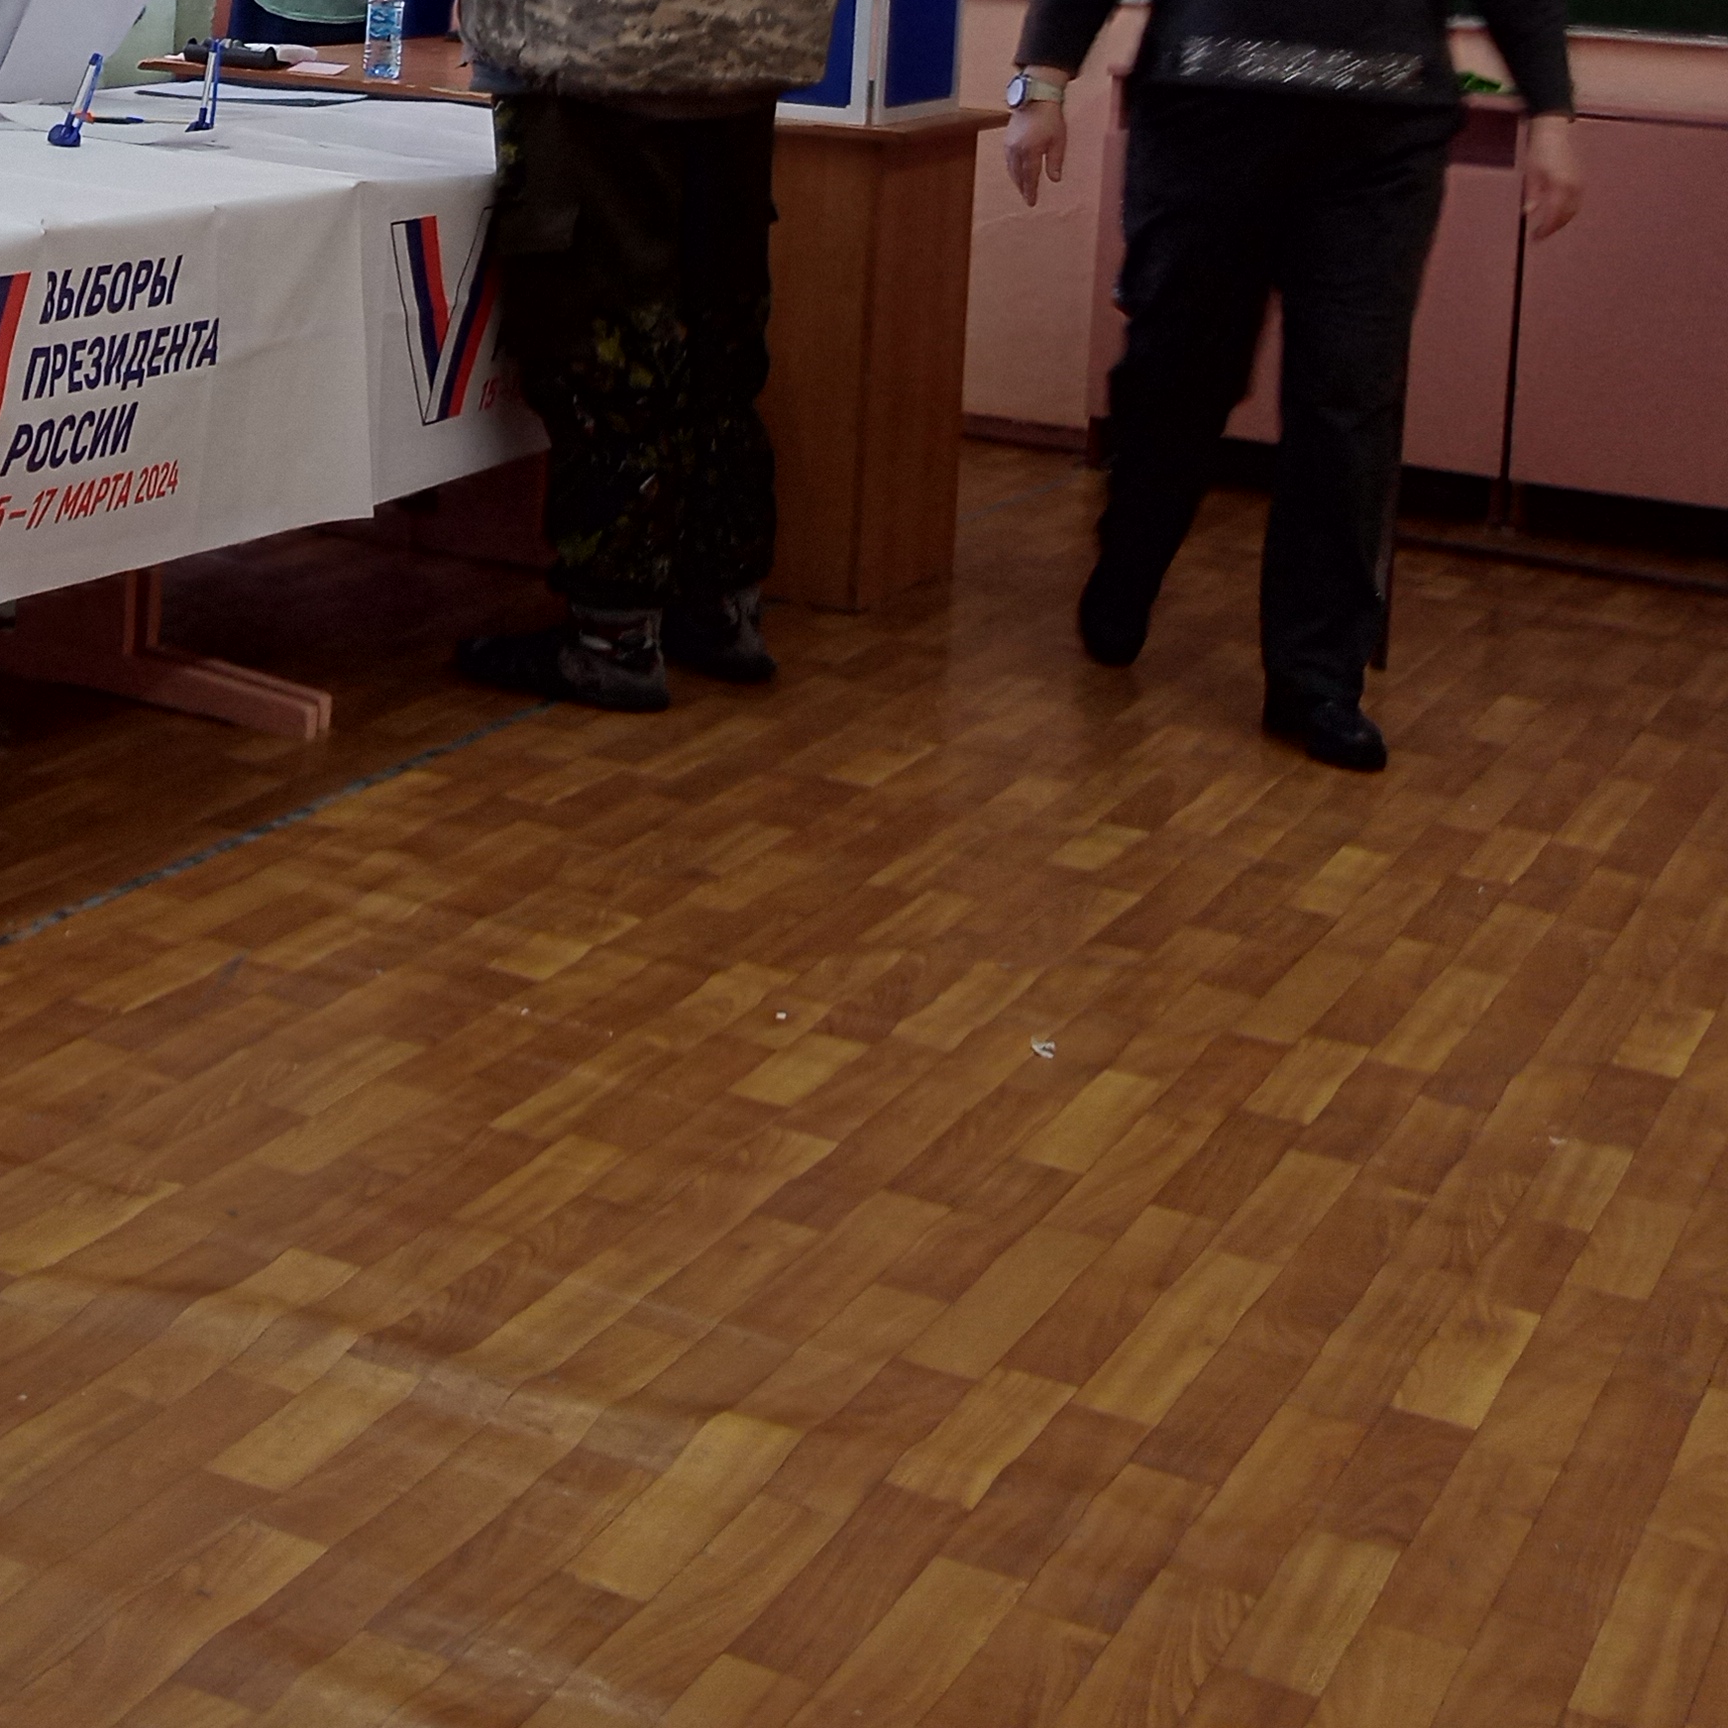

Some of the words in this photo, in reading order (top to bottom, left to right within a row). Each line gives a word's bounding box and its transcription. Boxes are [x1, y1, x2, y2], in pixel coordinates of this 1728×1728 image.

[39, 254, 183, 325] ВЫБОРЫ
[22, 318, 220, 401] ПРЕЗИДЕНТА
[0, 402, 138, 477] РОССИИ
[57, 473, 133, 524] МАРТА
[134, 459, 179, 498] 2024
